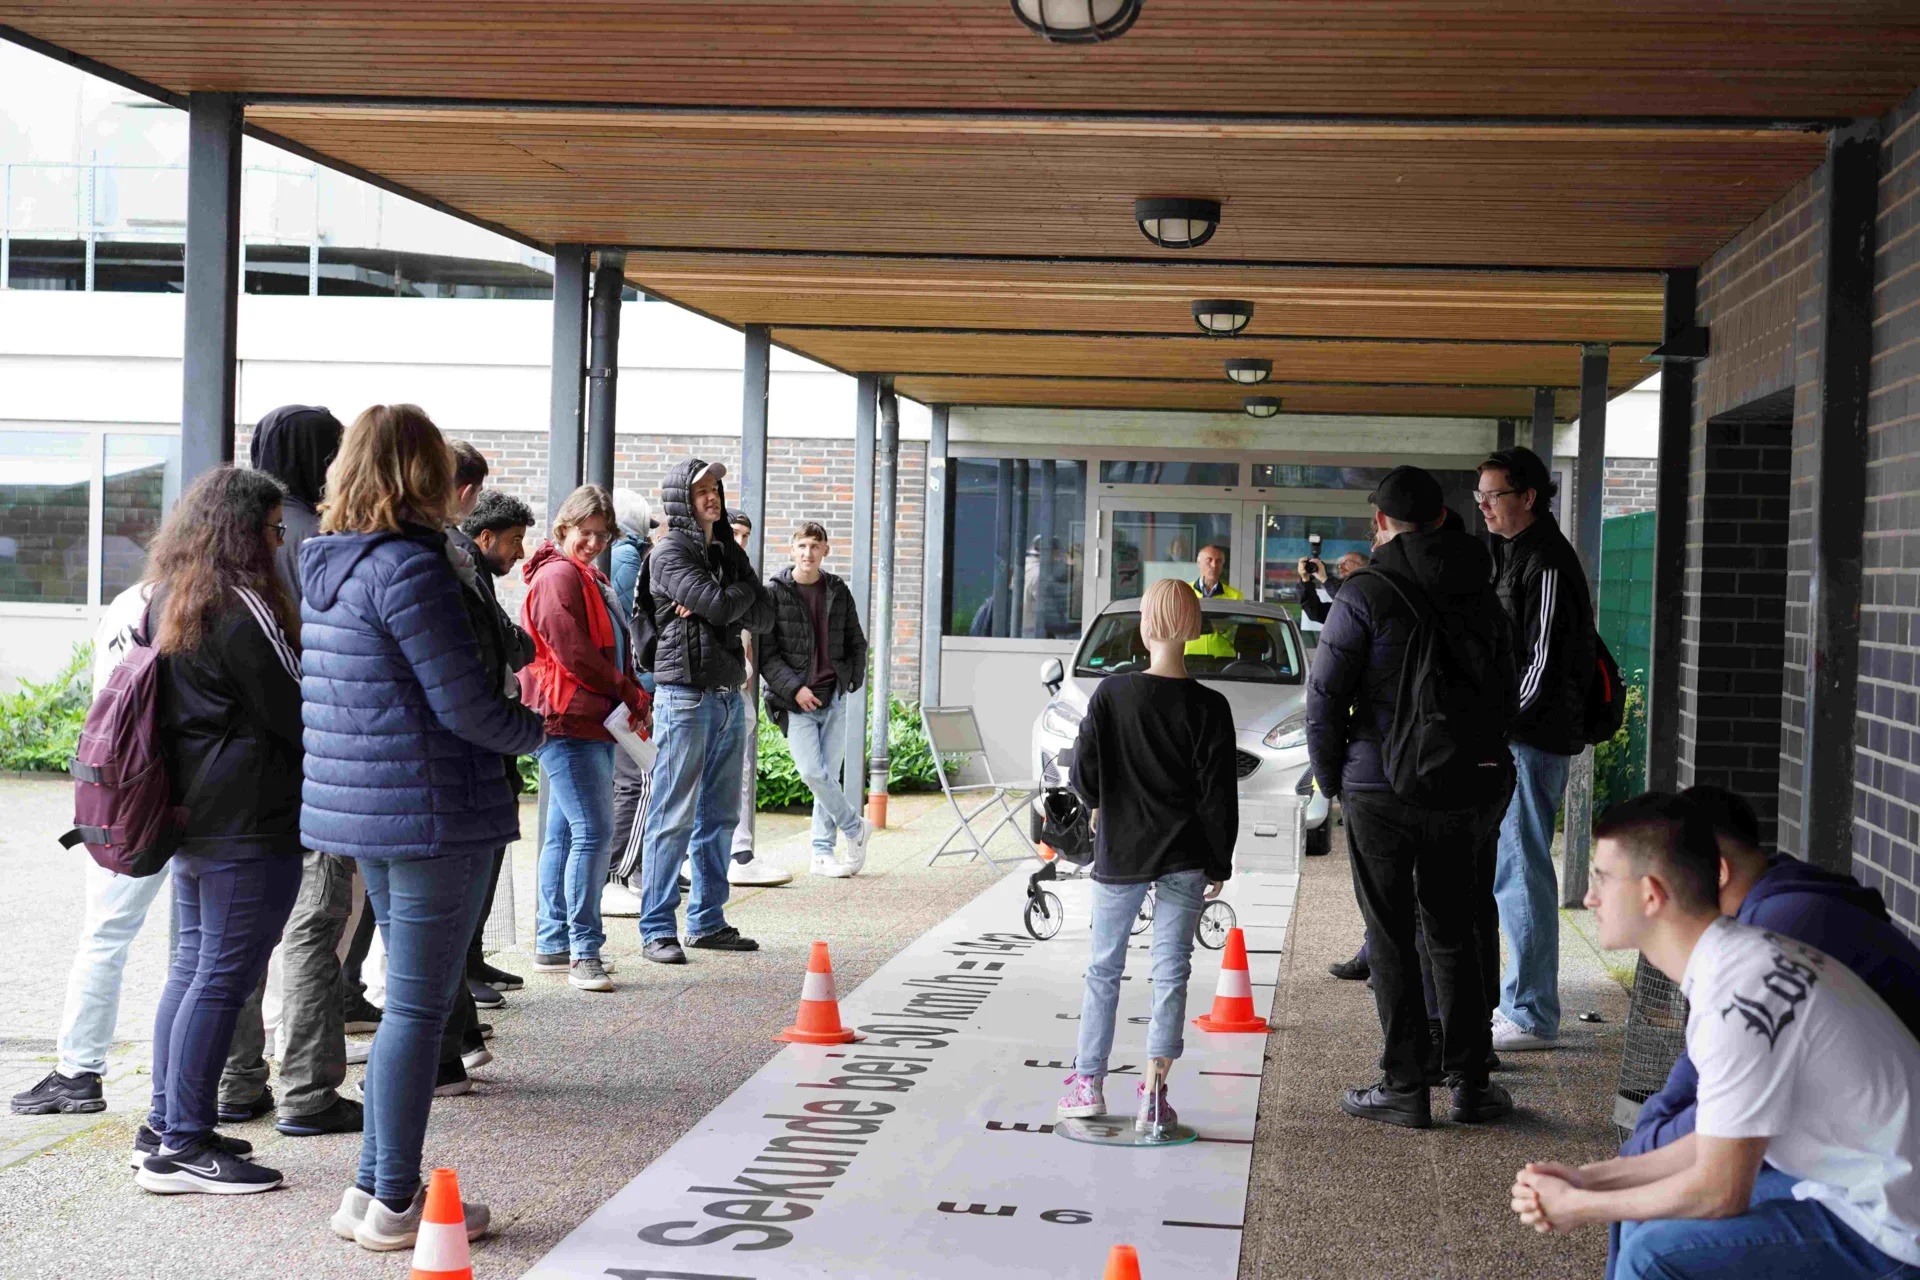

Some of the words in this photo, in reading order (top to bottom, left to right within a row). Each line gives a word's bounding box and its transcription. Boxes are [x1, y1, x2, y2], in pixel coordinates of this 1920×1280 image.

[871, 974, 1004, 1020] km/h
[848, 1024, 959, 1049] 50
[795, 1053, 933, 1092] bei
[637, 1100, 896, 1250] Sekunde
